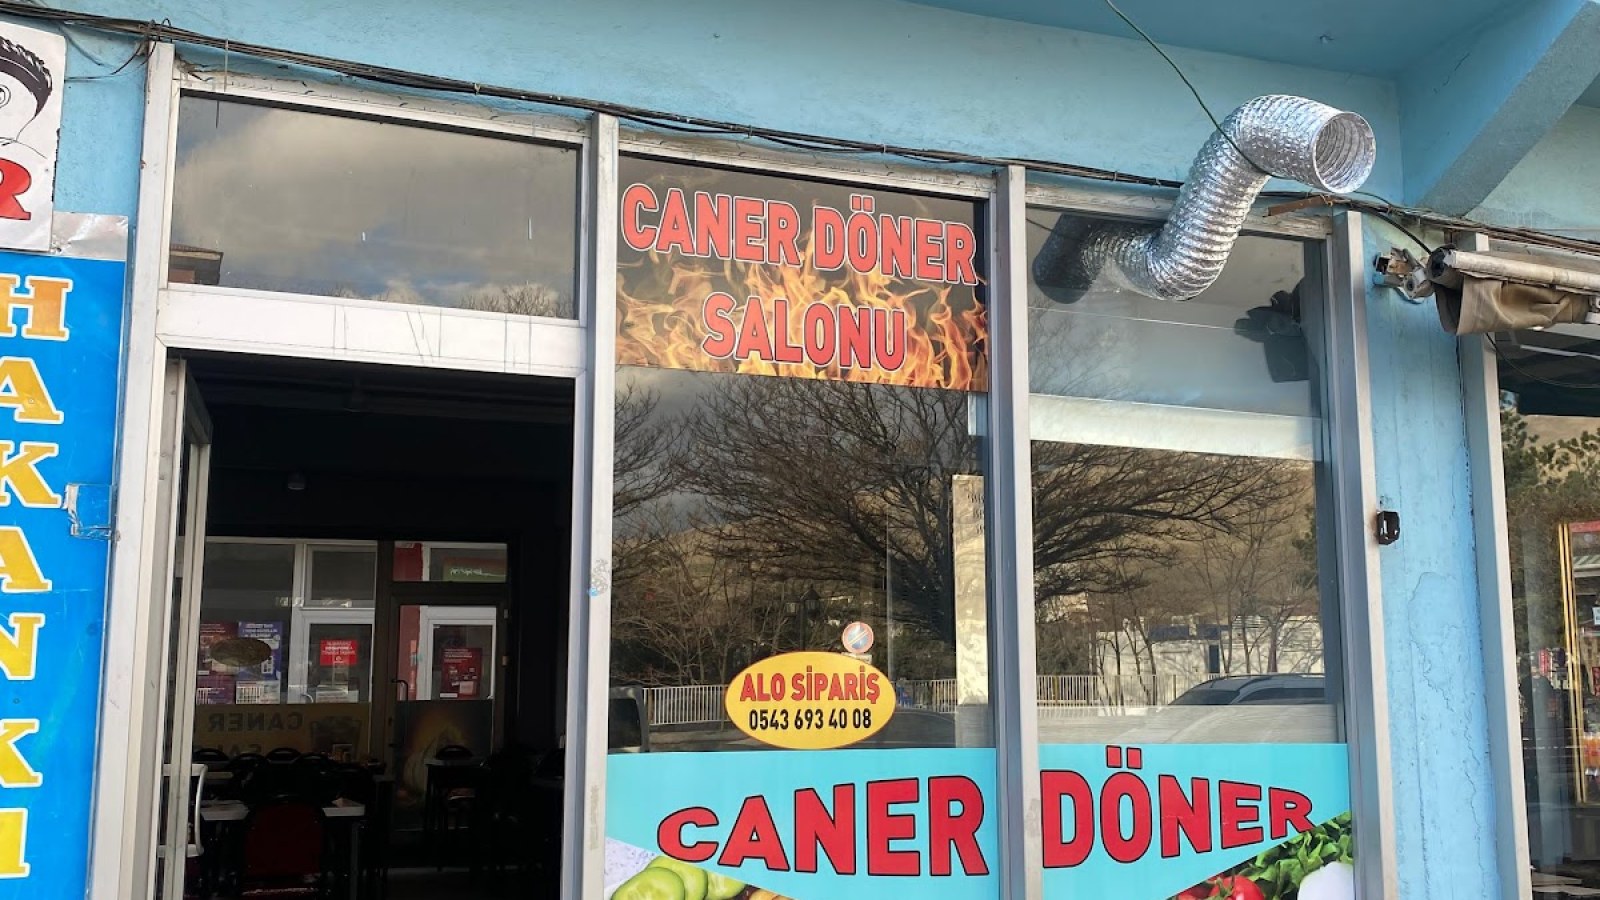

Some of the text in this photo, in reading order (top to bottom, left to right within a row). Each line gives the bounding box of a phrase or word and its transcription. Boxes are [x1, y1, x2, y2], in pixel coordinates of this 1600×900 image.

[621, 183, 978, 285] CANER DÖNER
[702, 291, 906, 372] SALONU
[740, 665, 880, 704] ALO SİPARİŞ
[750, 708, 872, 730] 0543 693 40 08
[657, 745, 1317, 876] CANER DÖNER
